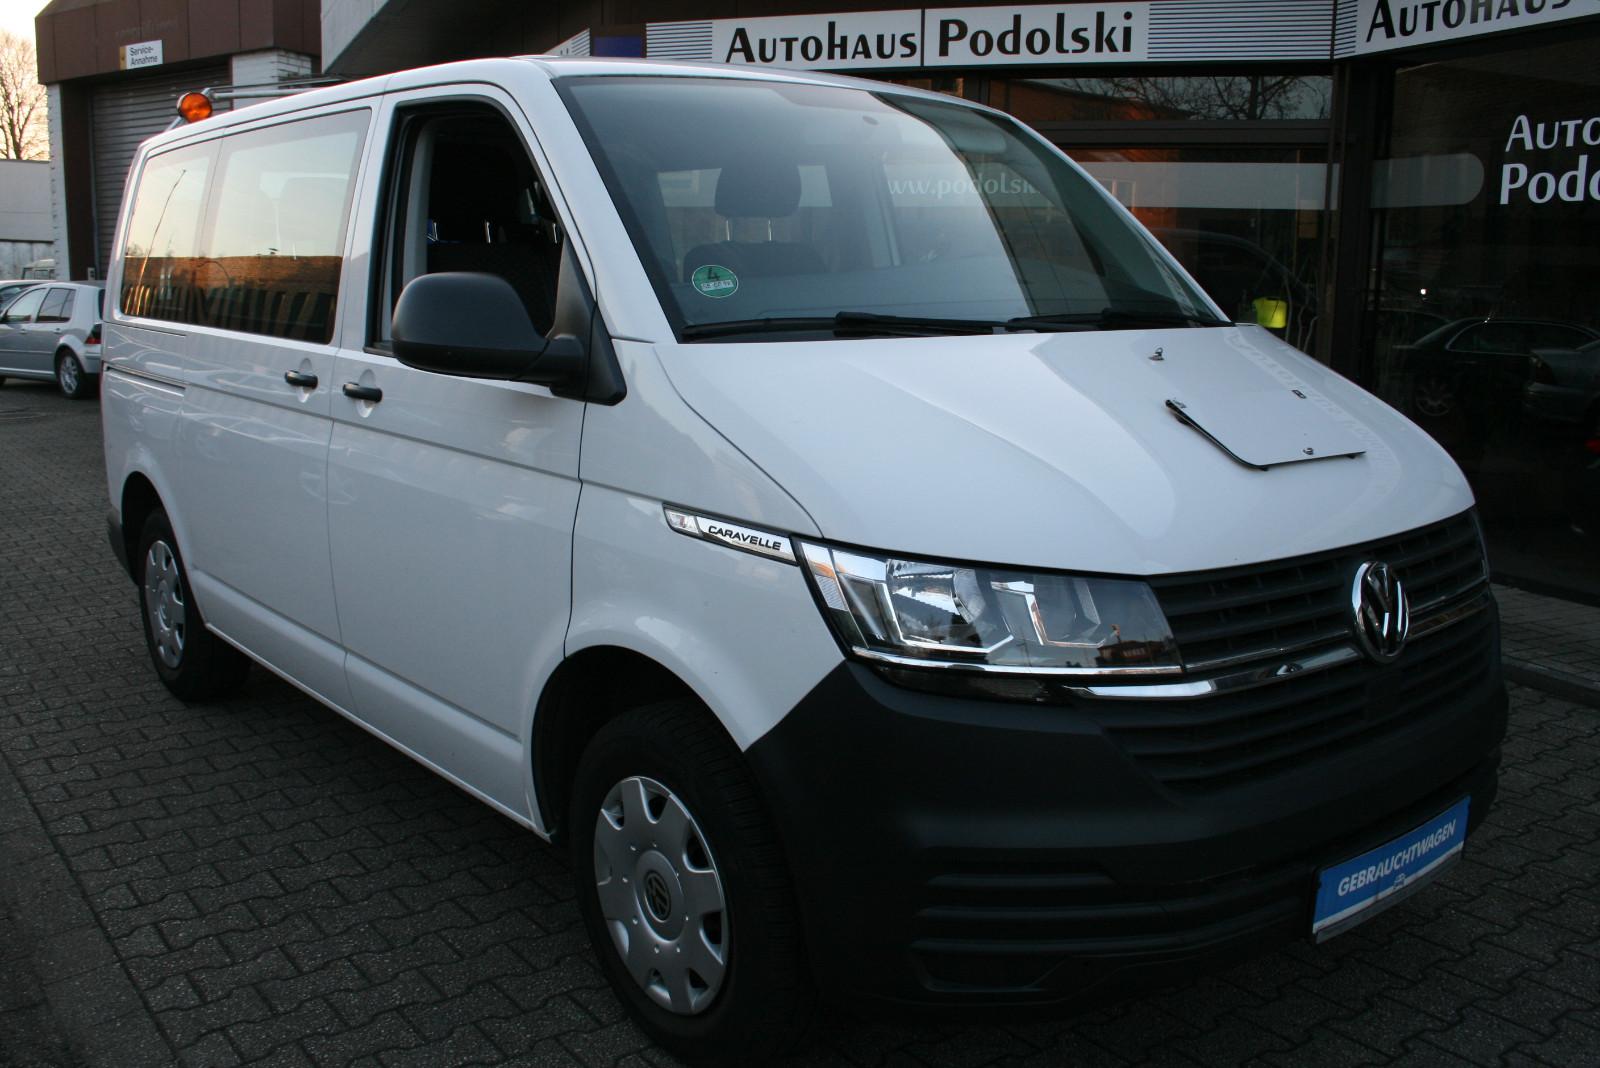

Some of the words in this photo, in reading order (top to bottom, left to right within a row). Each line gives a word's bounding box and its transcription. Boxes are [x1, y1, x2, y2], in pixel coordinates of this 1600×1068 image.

[938, 11, 1133, 57] Podolski
[130, 56, 158, 66] Annahme
[707, 267, 720, 281] 4
[708, 525, 782, 551] CARAVELLE
[1337, 818, 1456, 897] GEBRAUCHTWAGEN
